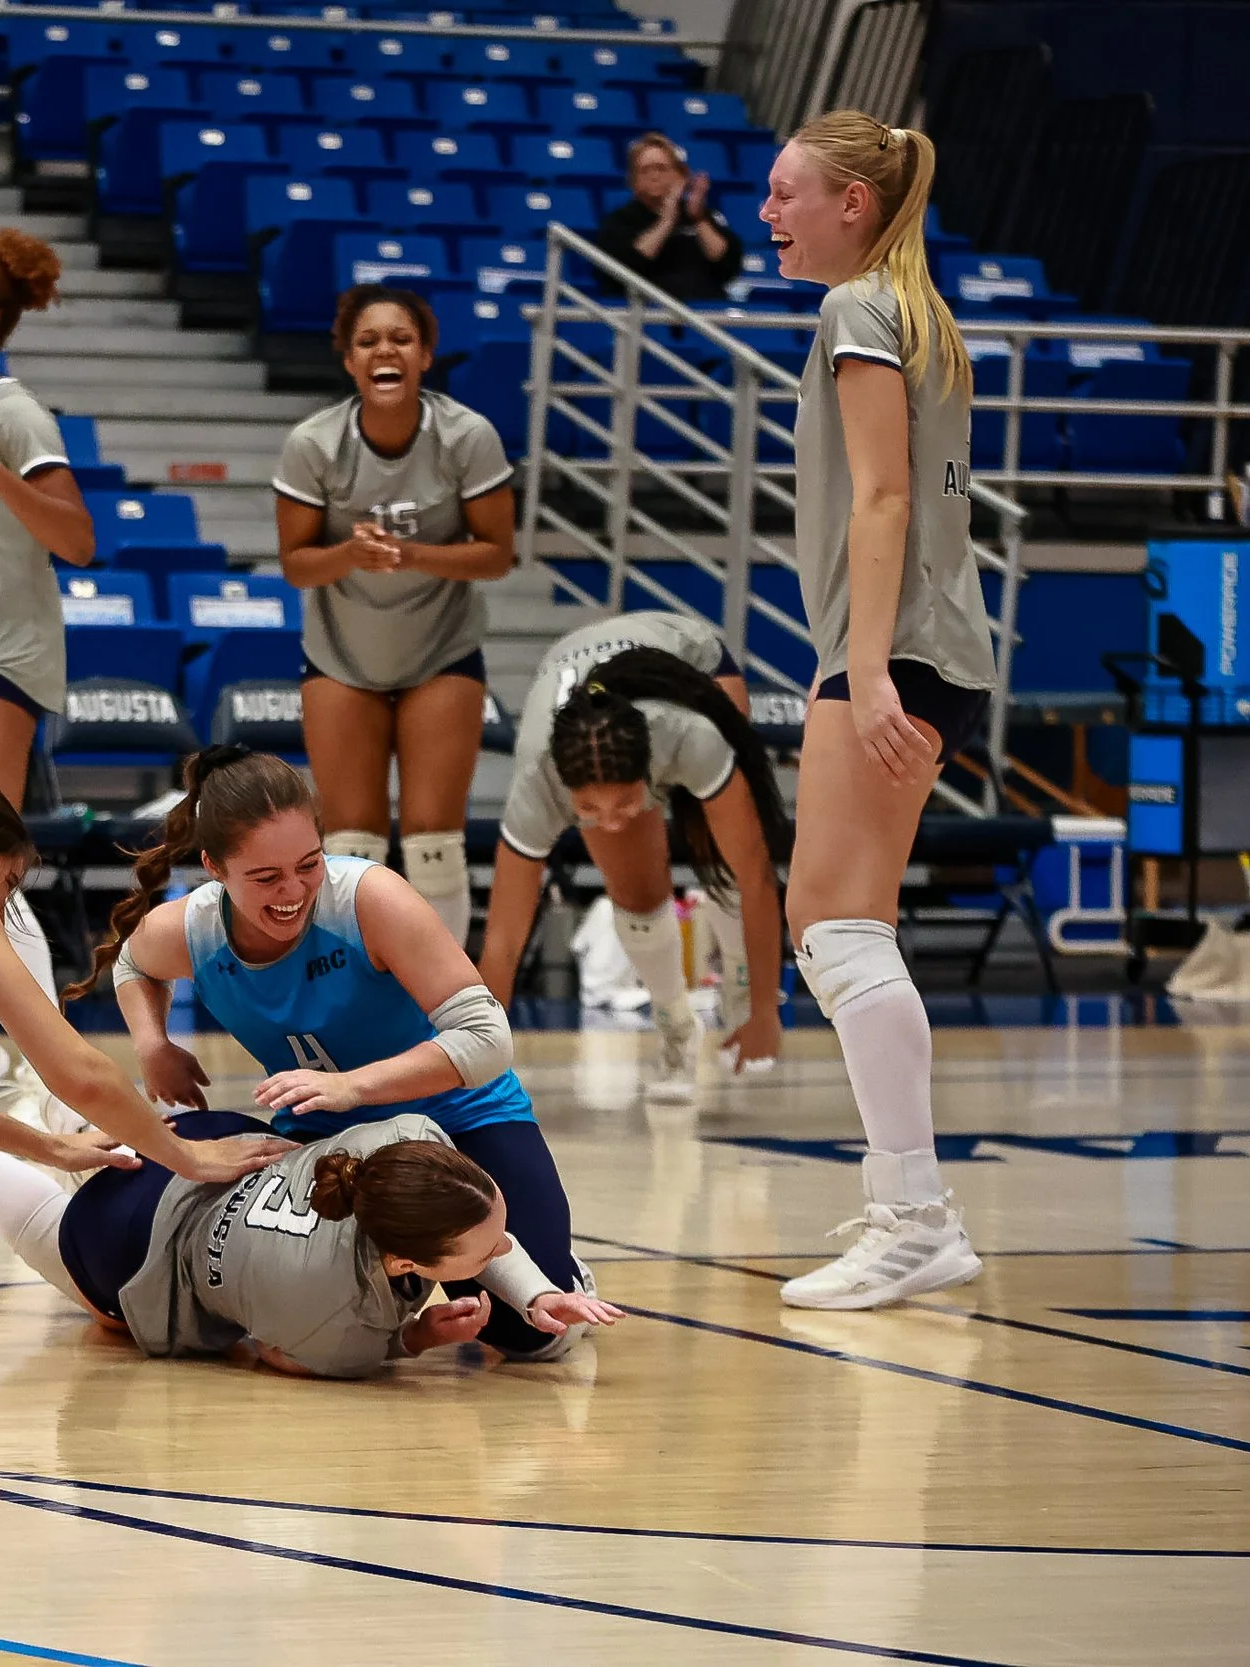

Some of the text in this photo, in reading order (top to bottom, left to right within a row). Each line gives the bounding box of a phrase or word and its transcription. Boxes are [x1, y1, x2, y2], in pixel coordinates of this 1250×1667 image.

[369, 501, 418, 540] 15
[66, 688, 179, 724] AUGUSTA
[286, 1033, 341, 1073] 4
[244, 1174, 321, 1239] 3
